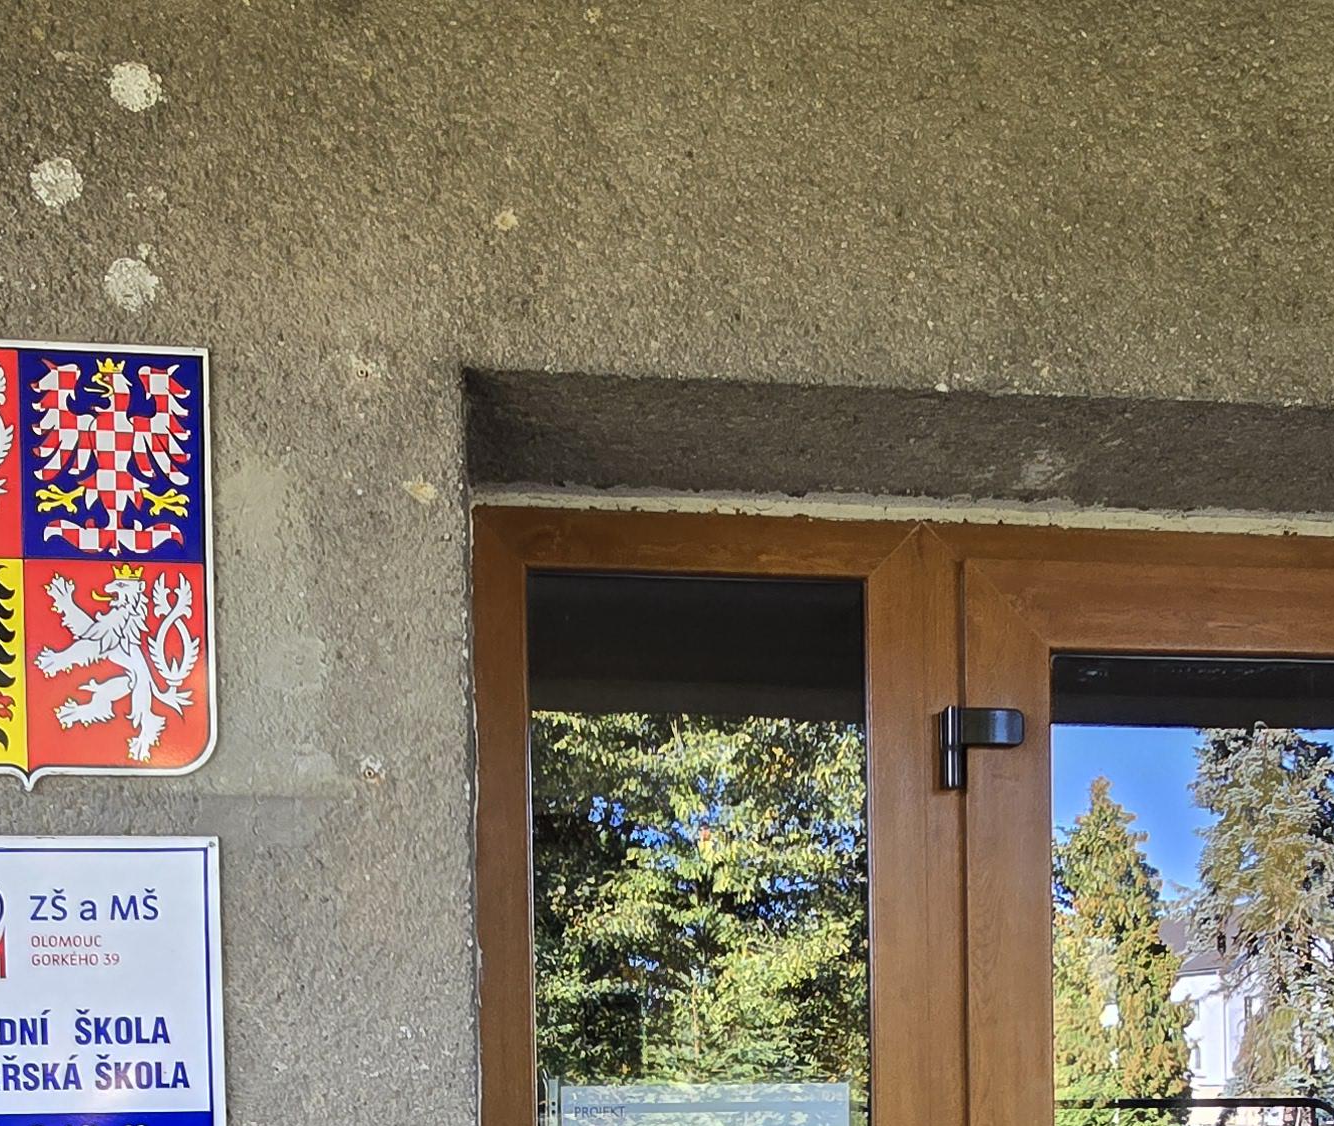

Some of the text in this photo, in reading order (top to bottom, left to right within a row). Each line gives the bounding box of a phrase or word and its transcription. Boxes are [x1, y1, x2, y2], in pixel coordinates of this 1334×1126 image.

[29, 888, 159, 921] ZŠ a MŠ
[30, 934, 102, 948] OLOMOUC
[31, 951, 120, 966] GORKÉHO 39
[74, 1008, 171, 1045] ŠKOLA
[94, 1054, 191, 1091] ŠKOLA
[573, 1105, 626, 1118] PROJEKT
